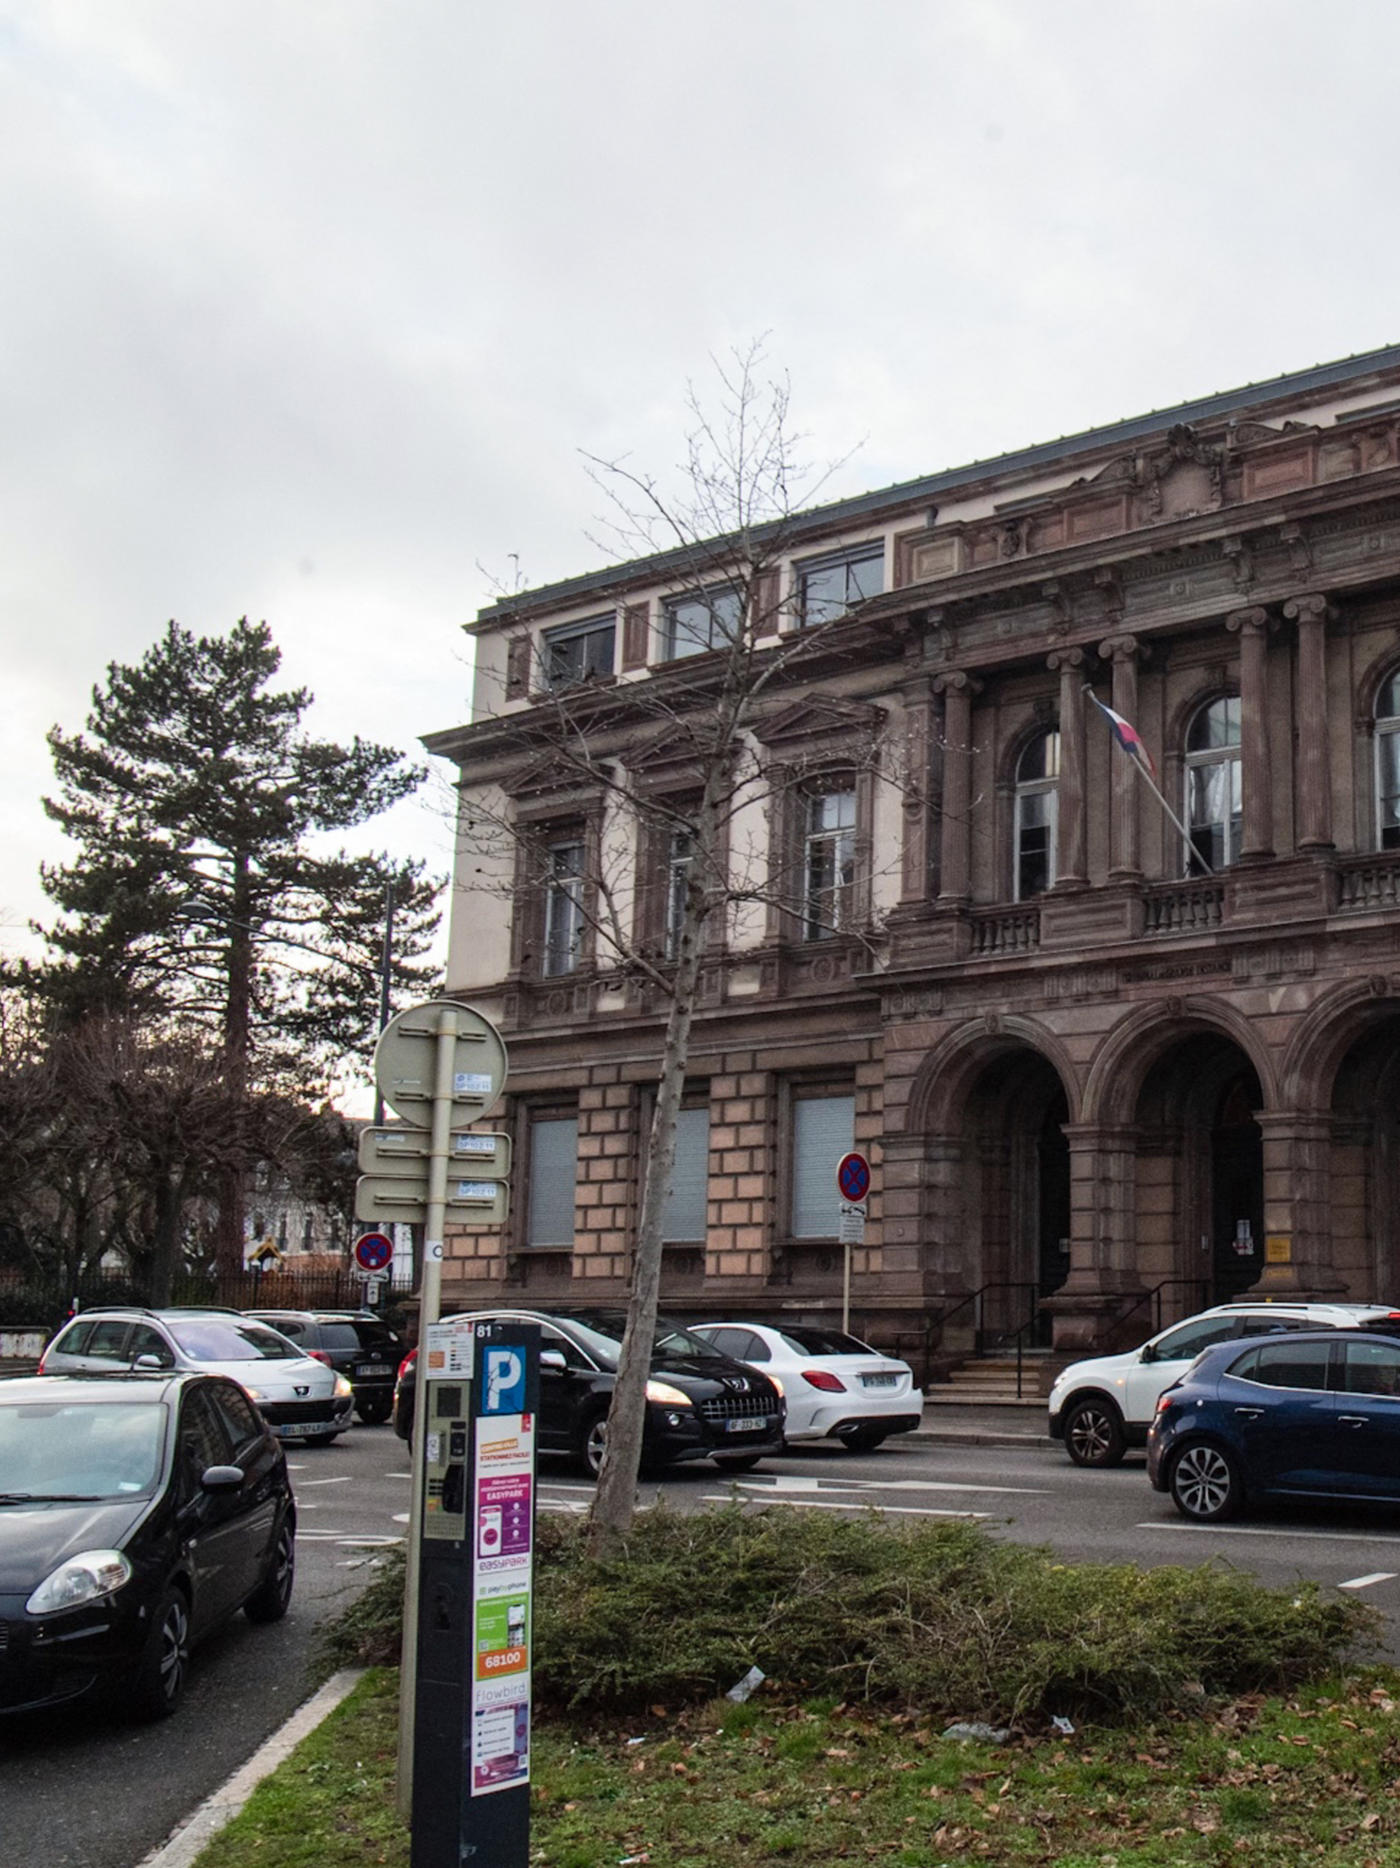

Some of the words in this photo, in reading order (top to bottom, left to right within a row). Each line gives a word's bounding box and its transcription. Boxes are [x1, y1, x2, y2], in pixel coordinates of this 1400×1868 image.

[477, 1325, 492, 1337] 81
[488, 1351, 522, 1410] P
[486, 1489, 524, 1500] EASYPARK
[485, 1651, 521, 1669] 68100
[476, 1683, 526, 1701] flowbird
